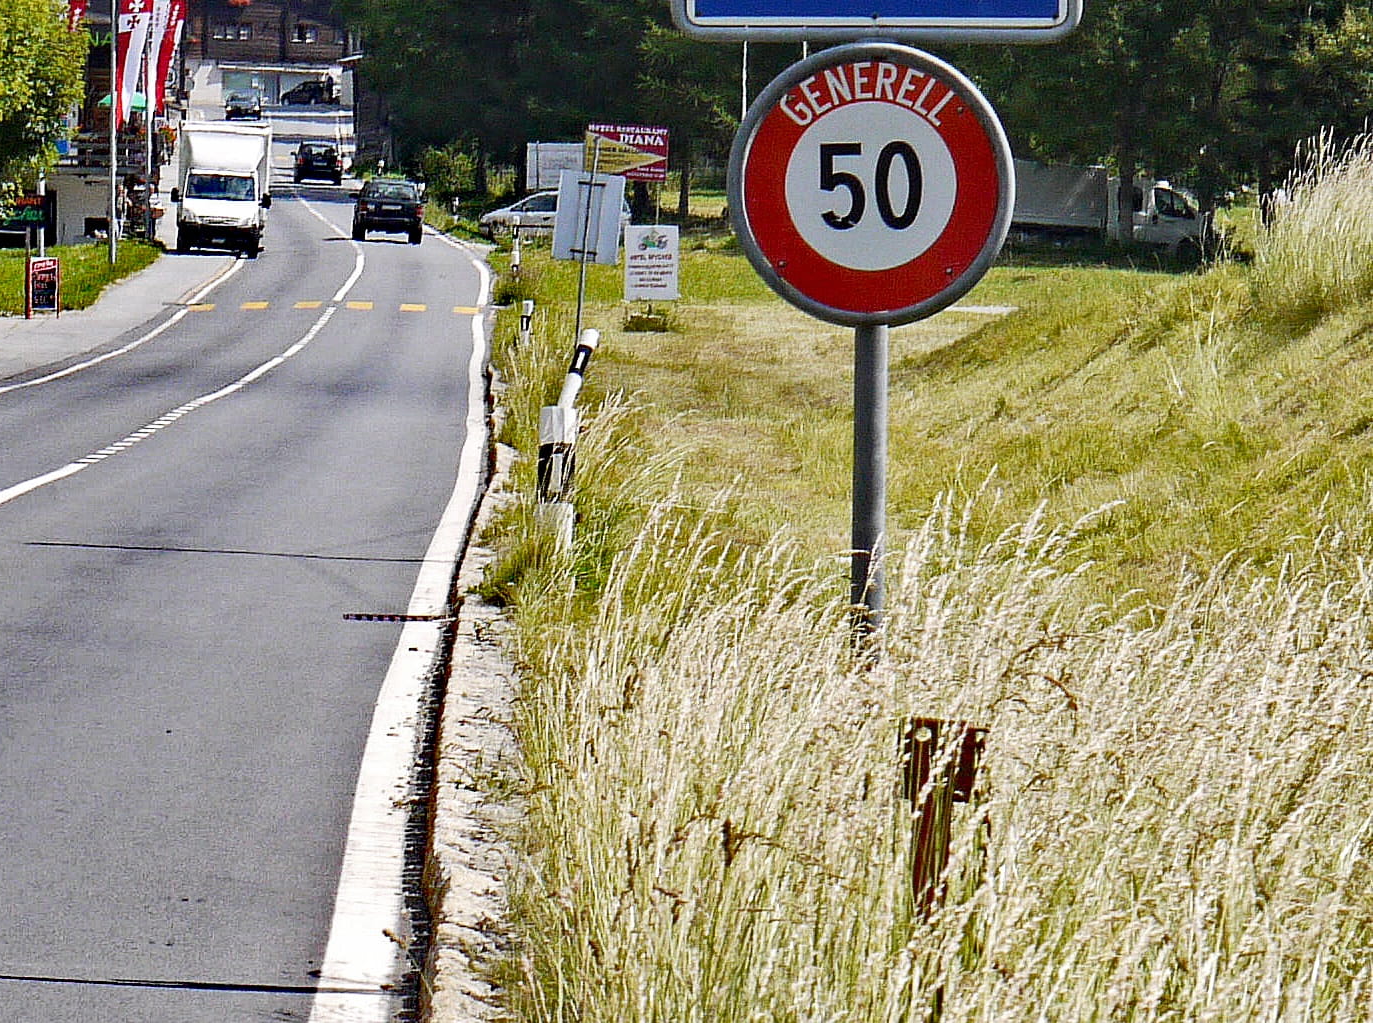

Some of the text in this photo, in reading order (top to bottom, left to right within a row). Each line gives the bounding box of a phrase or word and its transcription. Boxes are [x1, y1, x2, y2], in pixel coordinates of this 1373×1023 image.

[779, 60, 958, 128] GENERELL
[619, 133, 664, 146] DIANA
[818, 139, 924, 231] 50
